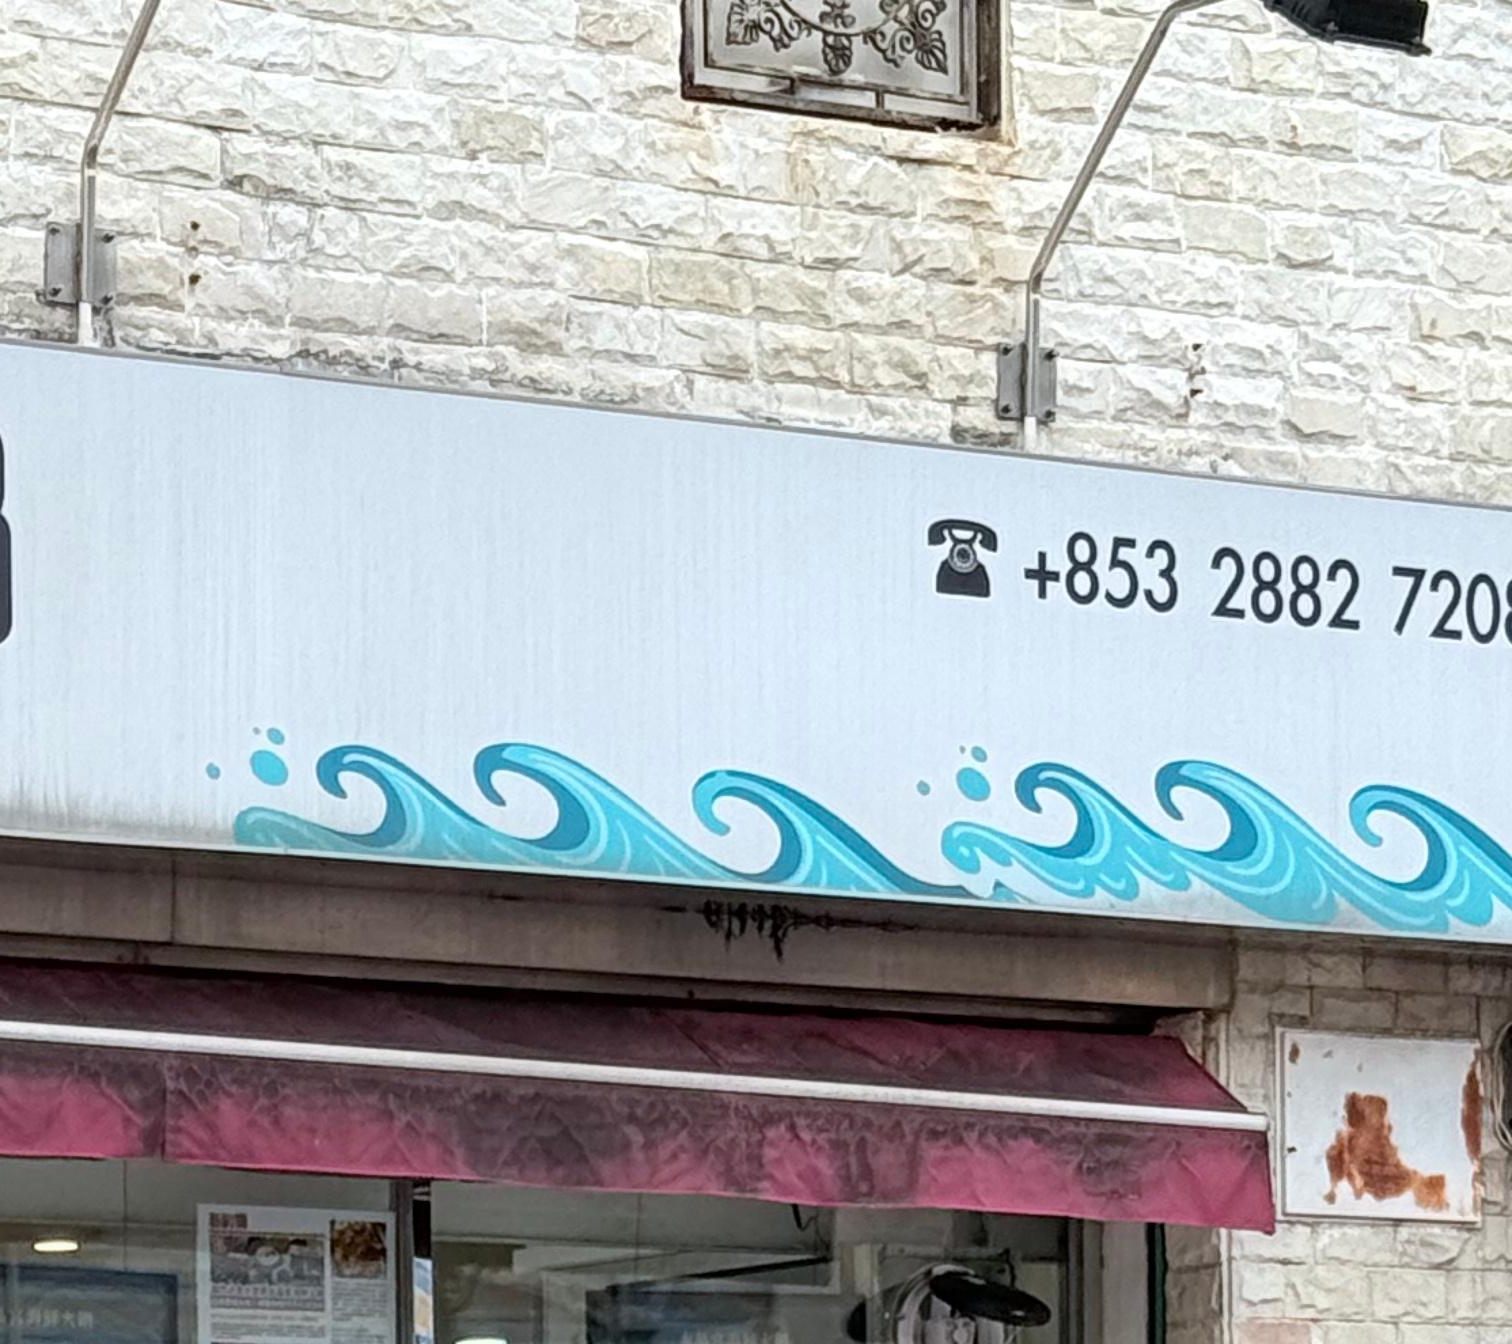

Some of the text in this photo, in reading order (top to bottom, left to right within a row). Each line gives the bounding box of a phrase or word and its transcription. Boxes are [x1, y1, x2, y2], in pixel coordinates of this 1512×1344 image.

[1023, 531, 1512, 645] +853 2882 720
